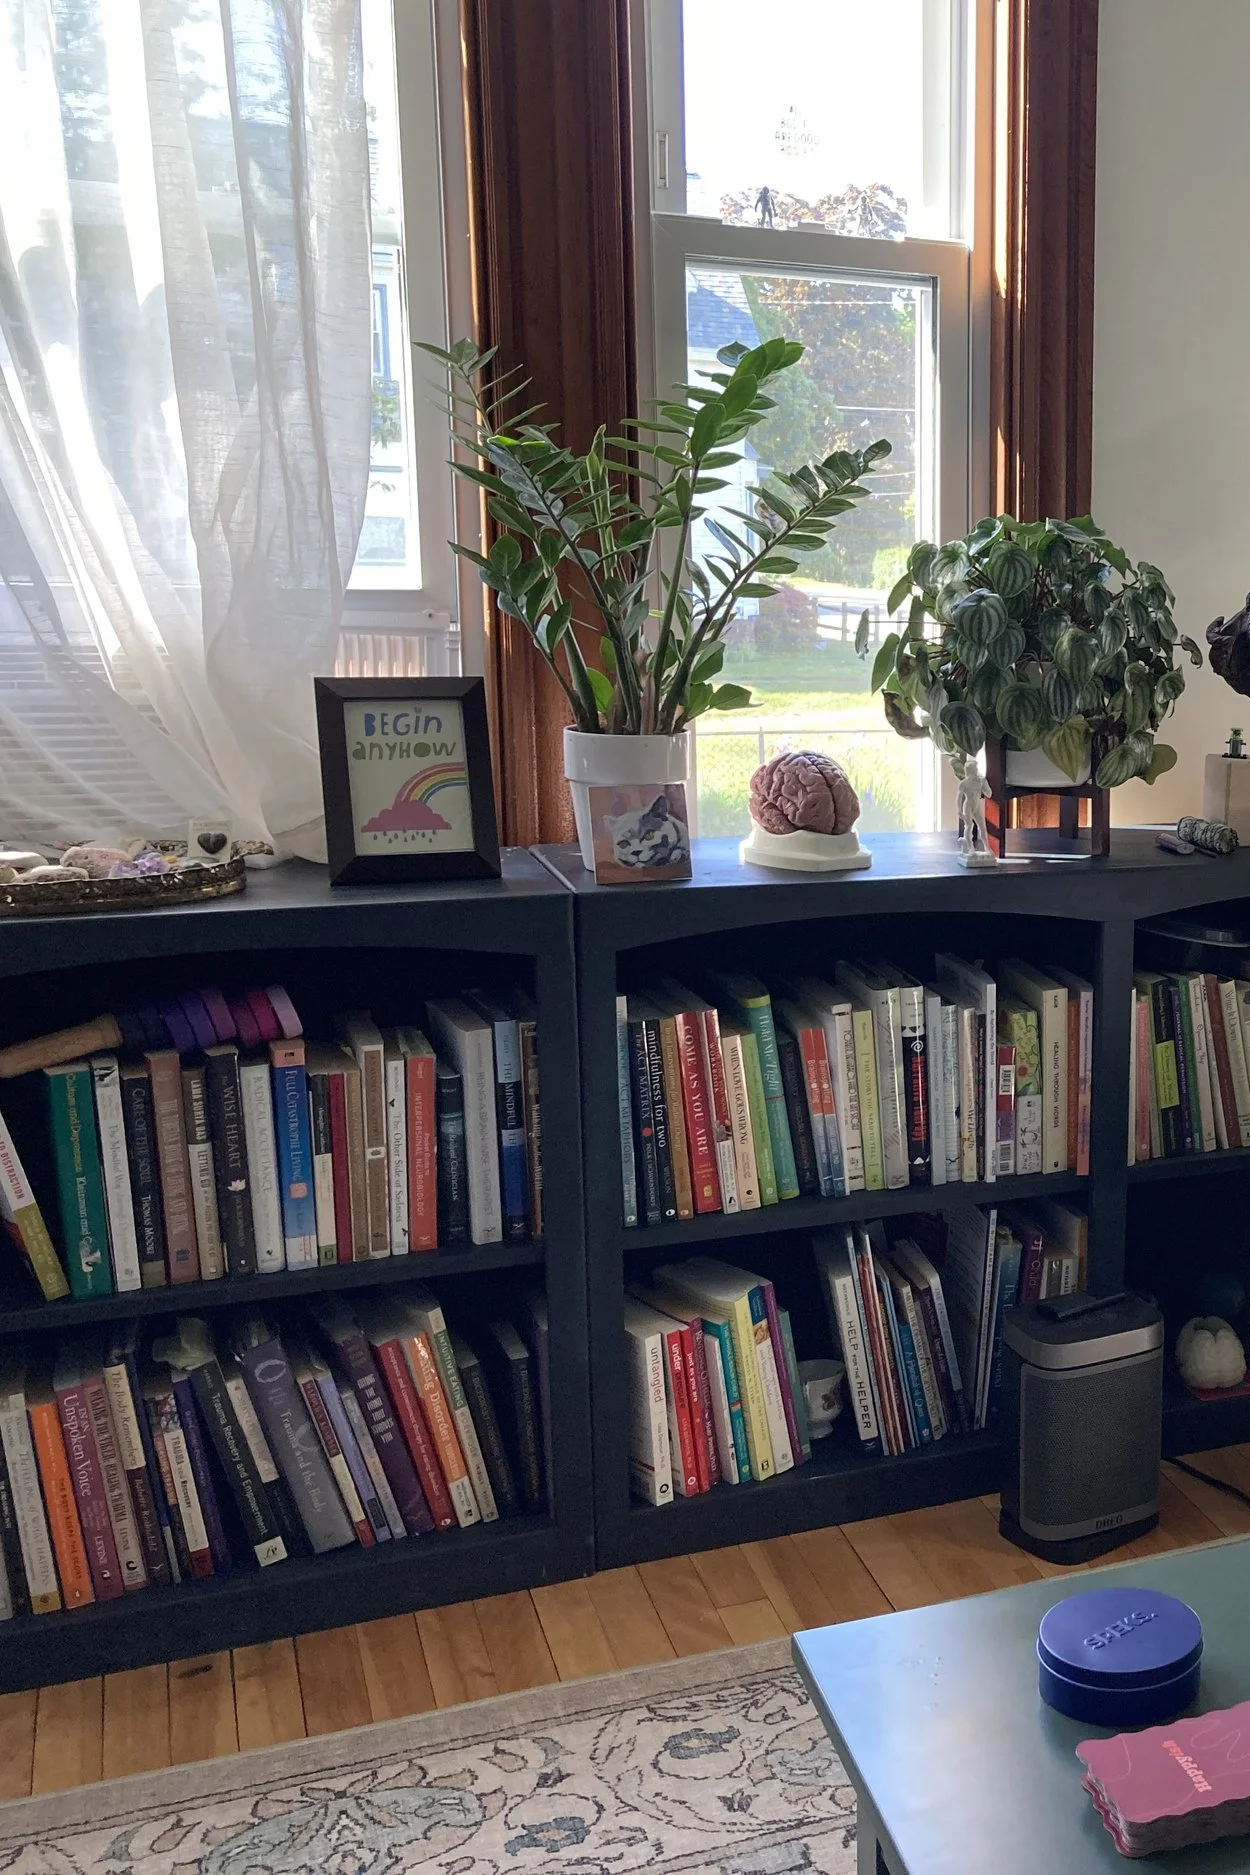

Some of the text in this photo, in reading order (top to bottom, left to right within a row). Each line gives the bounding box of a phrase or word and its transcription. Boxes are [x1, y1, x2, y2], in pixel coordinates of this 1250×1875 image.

[363, 706, 443, 737] BEGin
[759, 1014, 772, 1042] Hold
[504, 1062, 514, 1082] THE
[636, 1049, 647, 1071] ACT
[647, 1029, 664, 1101] mindfulness
[709, 1042, 719, 1093] WORKBOOK
[764, 1061, 780, 1091] Tight
[191, 1079, 203, 1100] LAMA
[192, 1101, 205, 1122] SURYA
[253, 1075, 267, 1120] RADICAL
[505, 1083, 517, 1129] MINDFUL
[639, 1075, 650, 1120] MATRIX
[655, 1104, 665, 1121] for
[683, 1025, 709, 1155] COME AS YOU ARE
[730, 1046, 748, 1145] WHEN LOVE GOES WRONG
[222, 1085, 242, 1169] WISE HEART
[656, 1126, 667, 1147] two
[0, 1152, 25, 1200] DISTRACTION
[196, 1150, 209, 1177] LETTING
[290, 1151, 305, 1181] LIVING
[393, 1114, 406, 1223] The Other Side of Sadness
[414, 1092, 425, 1217] INTERPERSONAL NEUROBIOLOGY
[140, 1194, 156, 1255] THOMAS MOORE
[437, 1332, 464, 1408] INTUITIVE EATING
[649, 1346, 663, 1403] untangled
[671, 1343, 682, 1371] under
[686, 1352, 695, 1366] just
[846, 1319, 859, 1351] HELP
[857, 1381, 872, 1429] HELPER
[689, 1376, 697, 1390] you
[280, 1409, 300, 1449] Trauma
[429, 1391, 453, 1442] Disorder
[62, 1394, 87, 1459] Unspoken
[75, 1460, 94, 1497] Voice
[94, 1535, 108, 1564] LEVINE
[171, 1436, 184, 1465] TRAUMA
[180, 1479, 192, 1508] RECOVERY
[211, 1392, 227, 1425] Trauma
[223, 1425, 242, 1461] Recovery
[236, 1463, 248, 1478] and
[242, 1479, 269, 1535] Empowerment
[1160, 1739, 1213, 1793] Happyish
